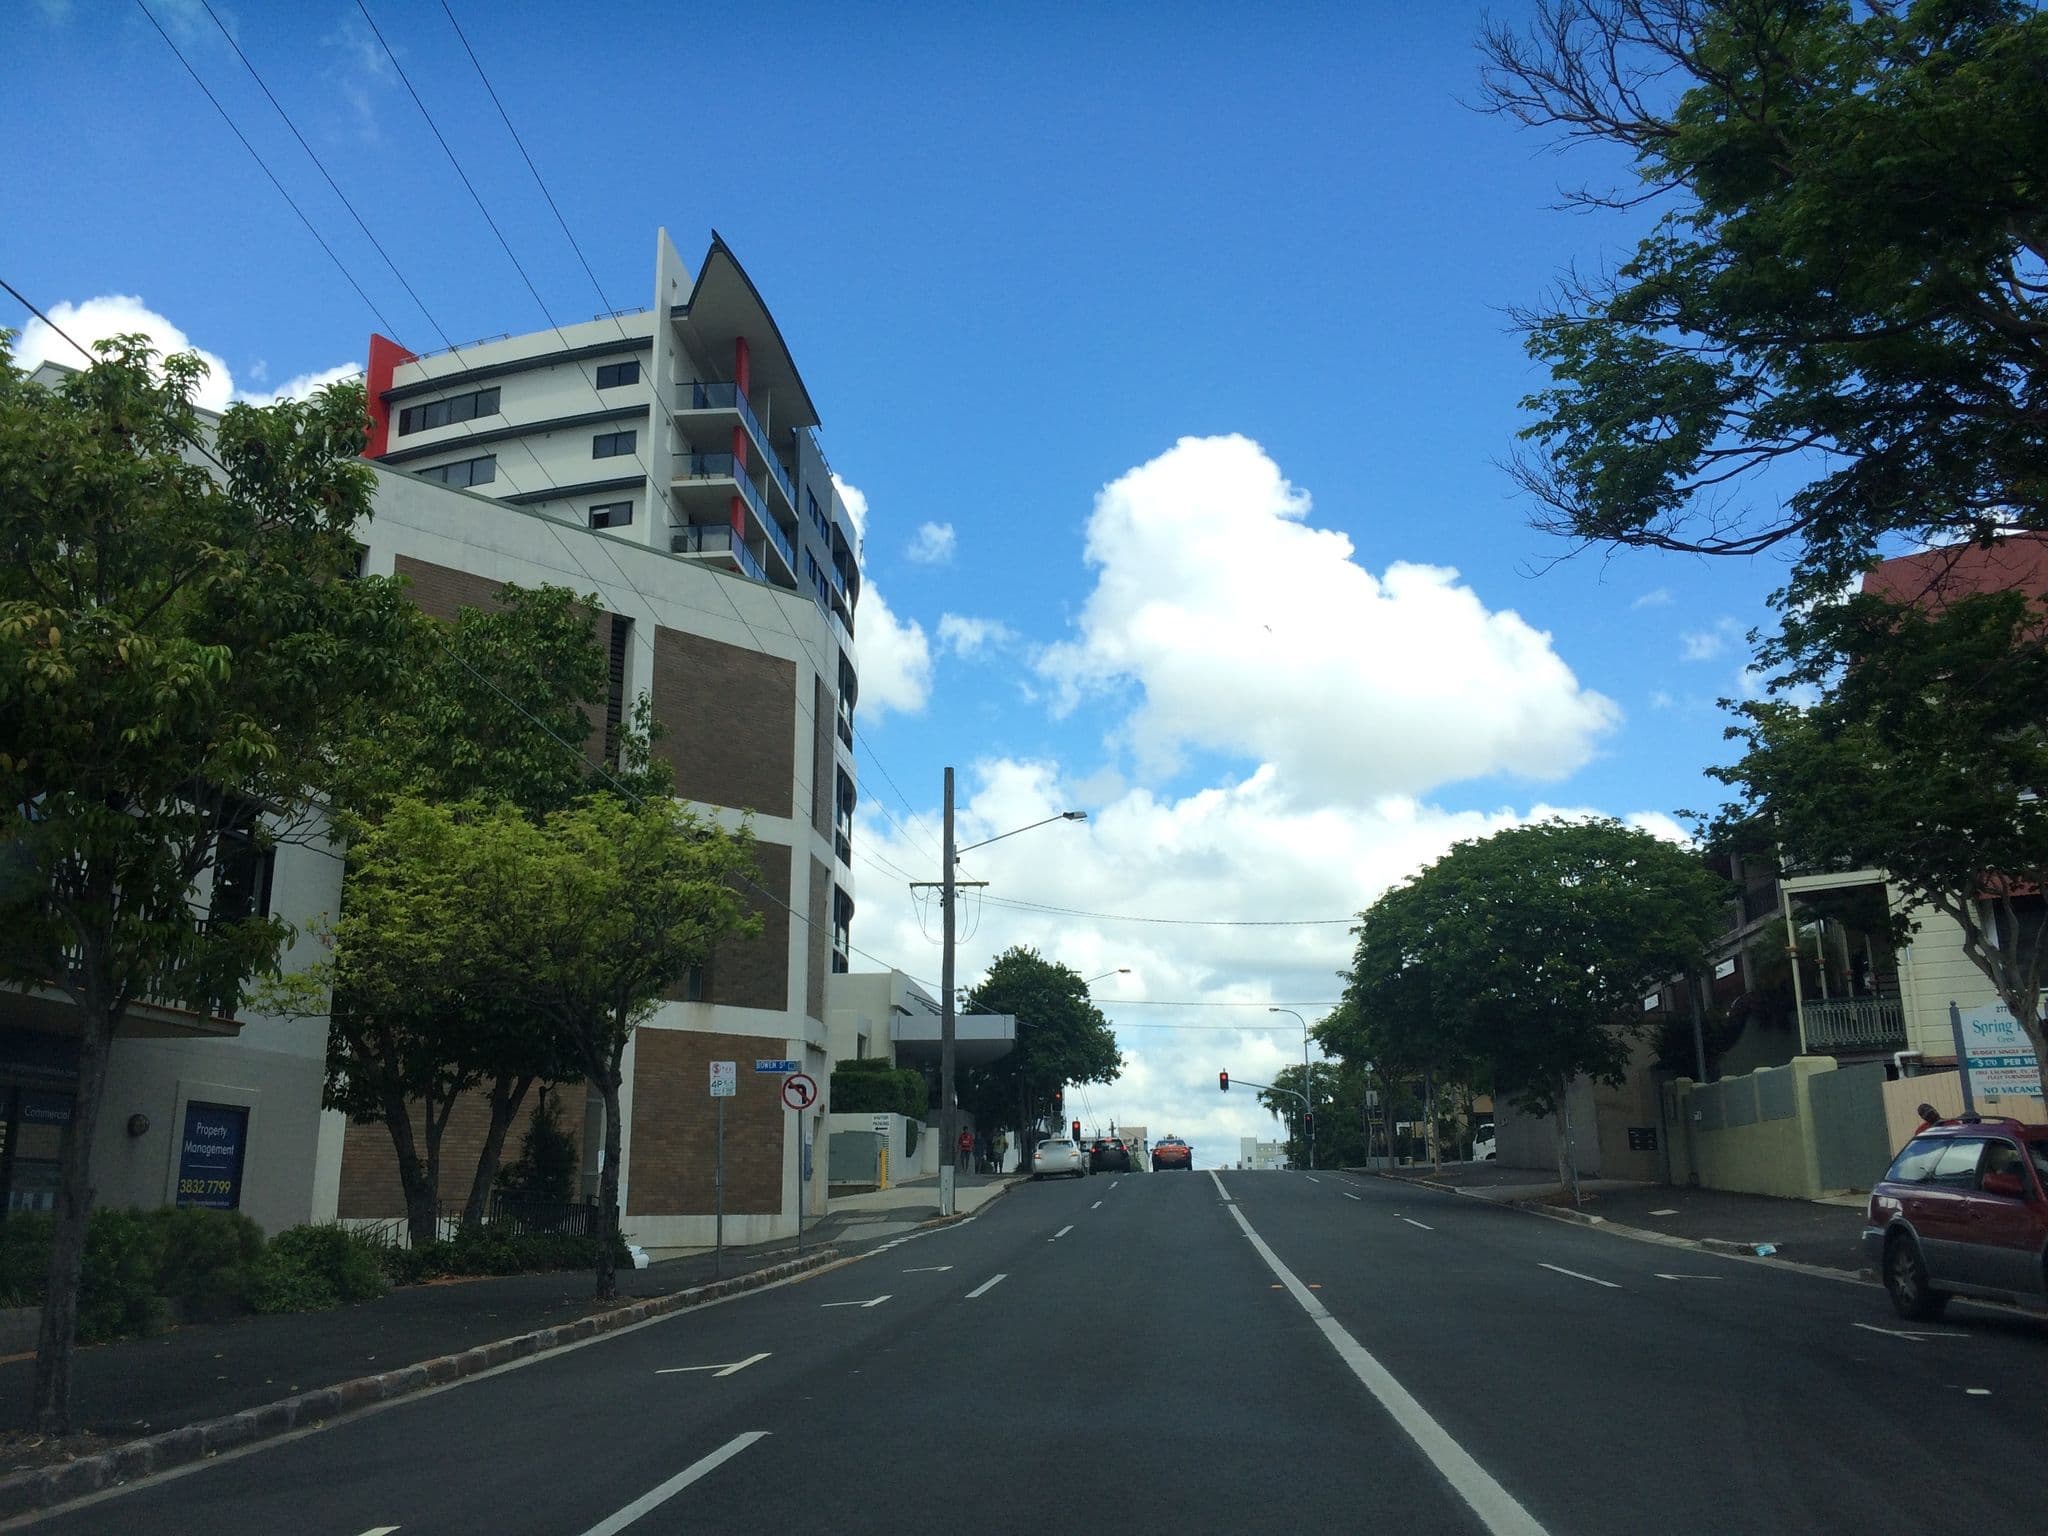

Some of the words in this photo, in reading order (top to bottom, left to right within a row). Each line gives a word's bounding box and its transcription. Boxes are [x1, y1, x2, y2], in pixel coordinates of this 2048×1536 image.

[1972, 1018, 2014, 1037] Spring
[2003, 1058, 2021, 1066] PER
[711, 1079, 723, 1088] 4P
[1983, 1086, 1999, 1094] NO
[196, 1121, 228, 1140] Property
[184, 1140, 235, 1157] Management
[179, 1178, 205, 1194] 3832
[206, 1179, 232, 1194] 7799
